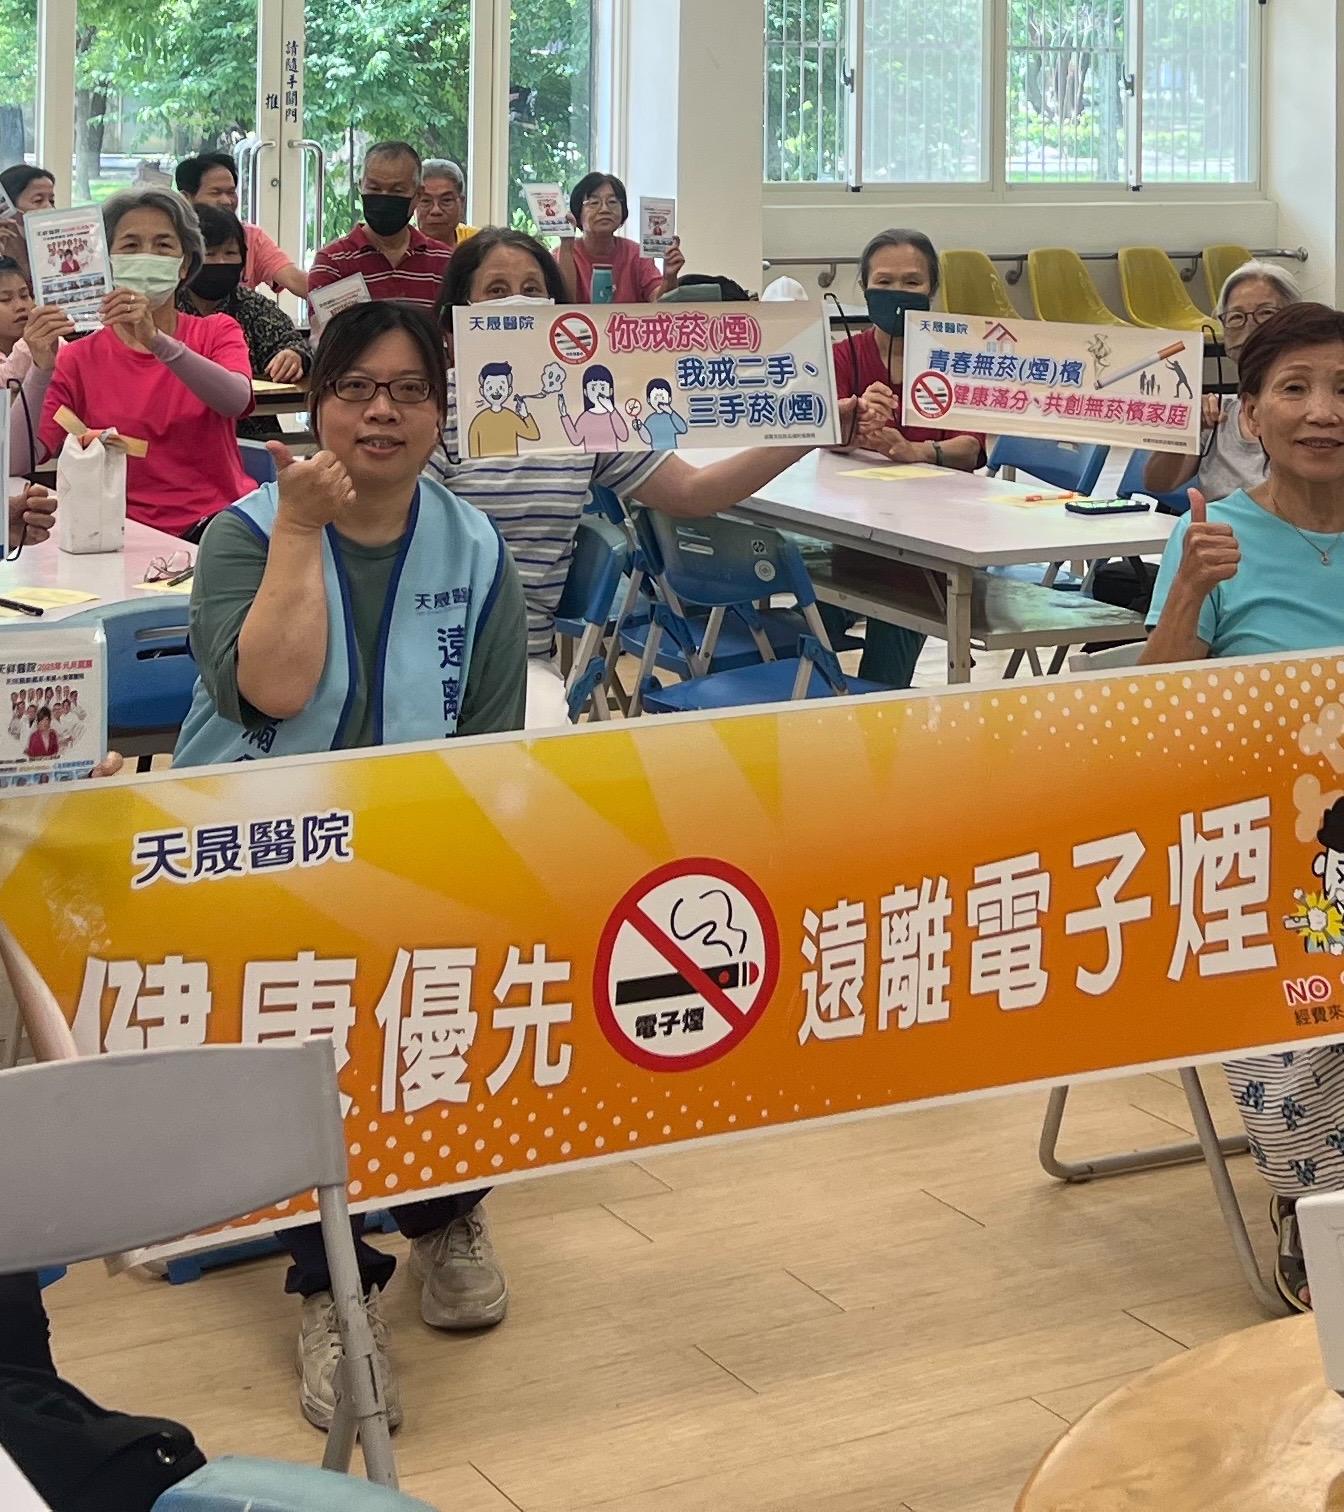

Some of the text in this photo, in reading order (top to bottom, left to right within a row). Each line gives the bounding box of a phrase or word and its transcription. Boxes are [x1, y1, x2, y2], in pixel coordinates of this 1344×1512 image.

[285, 40, 298, 123] 請隨手關門
[265, 92, 279, 110] 推
[469, 315, 535, 331] 天晟醫院
[607, 312, 762, 353] 你戒菸(煙)
[919, 319, 969, 335] 天晟醫院
[676, 354, 820, 389] 我戒二手、
[928, 348, 1084, 386] 青春無菸(煙)檳
[687, 392, 826, 429] 三手菸(煙)
[953, 383, 1190, 428] 健康滿分、共創無菸檳家庭
[415, 587, 472, 610] 天晟醫
[134, 811, 352, 888] 天晟醫院
[798, 796, 1278, 1046] 遠離電子煙
[1284, 978, 1331, 1005] NO
[634, 1007, 705, 1041] 電子煙
